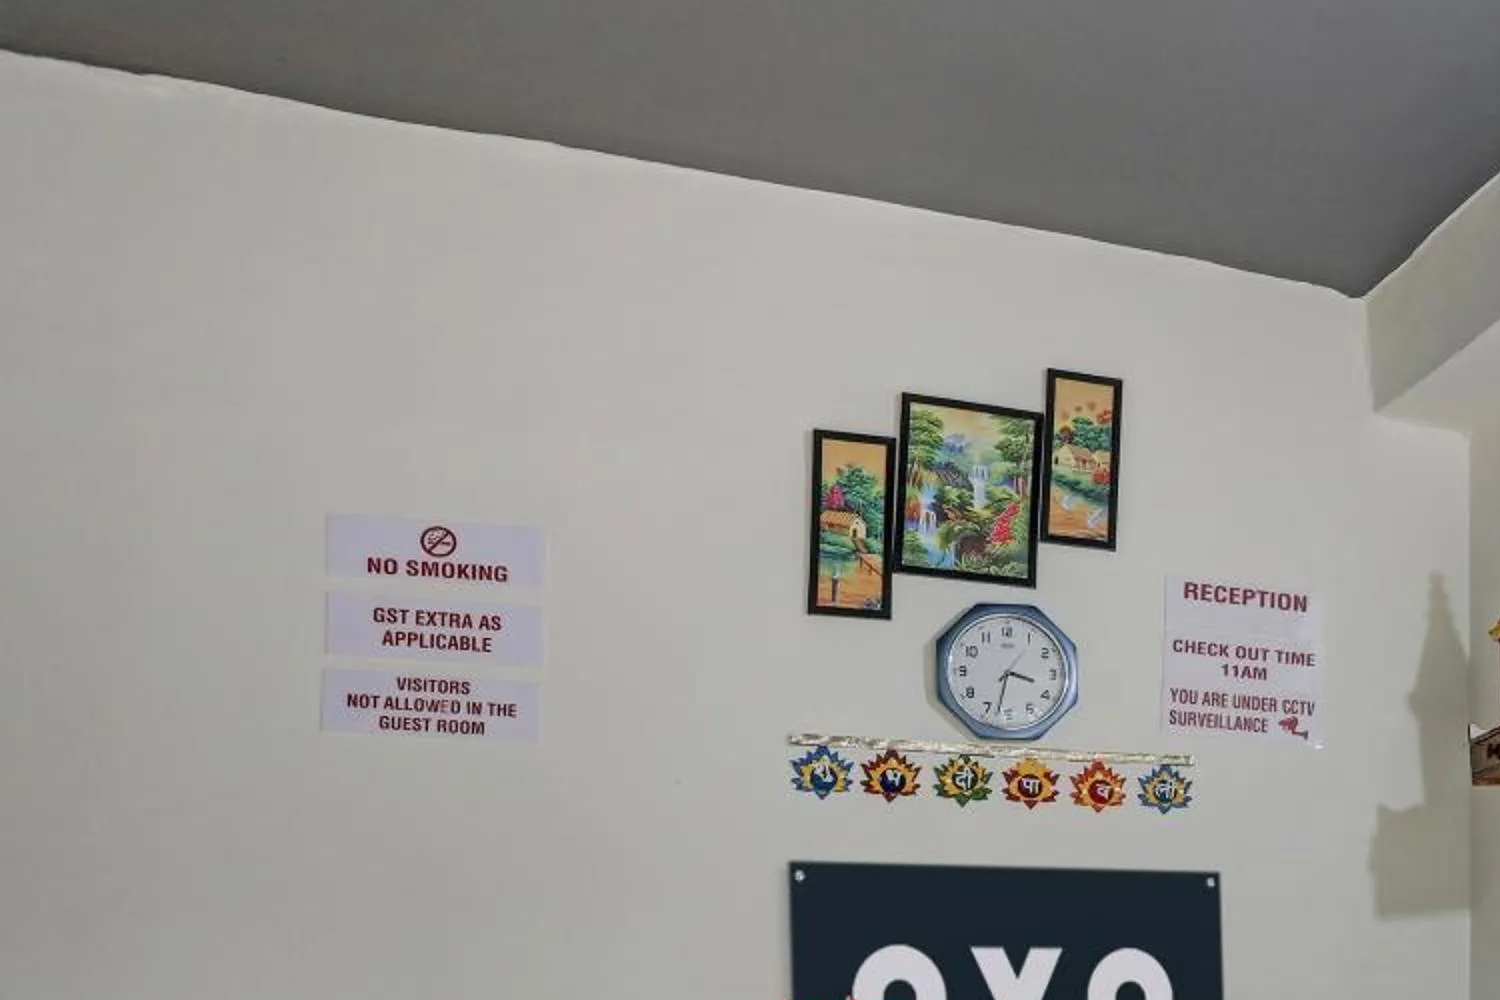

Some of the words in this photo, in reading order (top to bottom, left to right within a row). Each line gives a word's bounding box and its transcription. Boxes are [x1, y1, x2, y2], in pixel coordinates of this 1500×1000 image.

[367, 557, 398, 575] NO
[405, 559, 509, 582] SMOKING
[1184, 582, 1308, 612] RECEPTION
[373, 607, 409, 624] GST
[415, 610, 473, 629] EXTRA
[479, 615, 502, 630] AS
[382, 631, 492, 652] APPLICABLE
[981, 632, 991, 644] 11
[966, 645, 978, 658] 10
[1041, 647, 1049, 659] 2
[1172, 639, 1229, 657] CHECK
[1235, 645, 1270, 661] OUT
[1275, 650, 1316, 667] TIME
[1221, 664, 1267, 680] 11AM
[396, 677, 471, 695] VISITORS
[966, 687, 975, 699] 8
[1040, 689, 1051, 700] 4
[347, 694, 380, 709] NOT
[384, 696, 461, 714] ALLOWED
[467, 701, 482, 715] IN
[487, 703, 517, 718] THE
[983, 702, 992, 714] 7
[1025, 703, 1034, 715] 5
[1170, 688, 1198, 704] YOU
[1201, 691, 1229, 708] ARE
[1233, 694, 1277, 712] UNDER
[1282, 699, 1315, 716] CCTV
[379, 715, 432, 732] GUEST
[437, 719, 485, 735] ROOM
[1169, 710, 1269, 733] SURVEILLANCE
